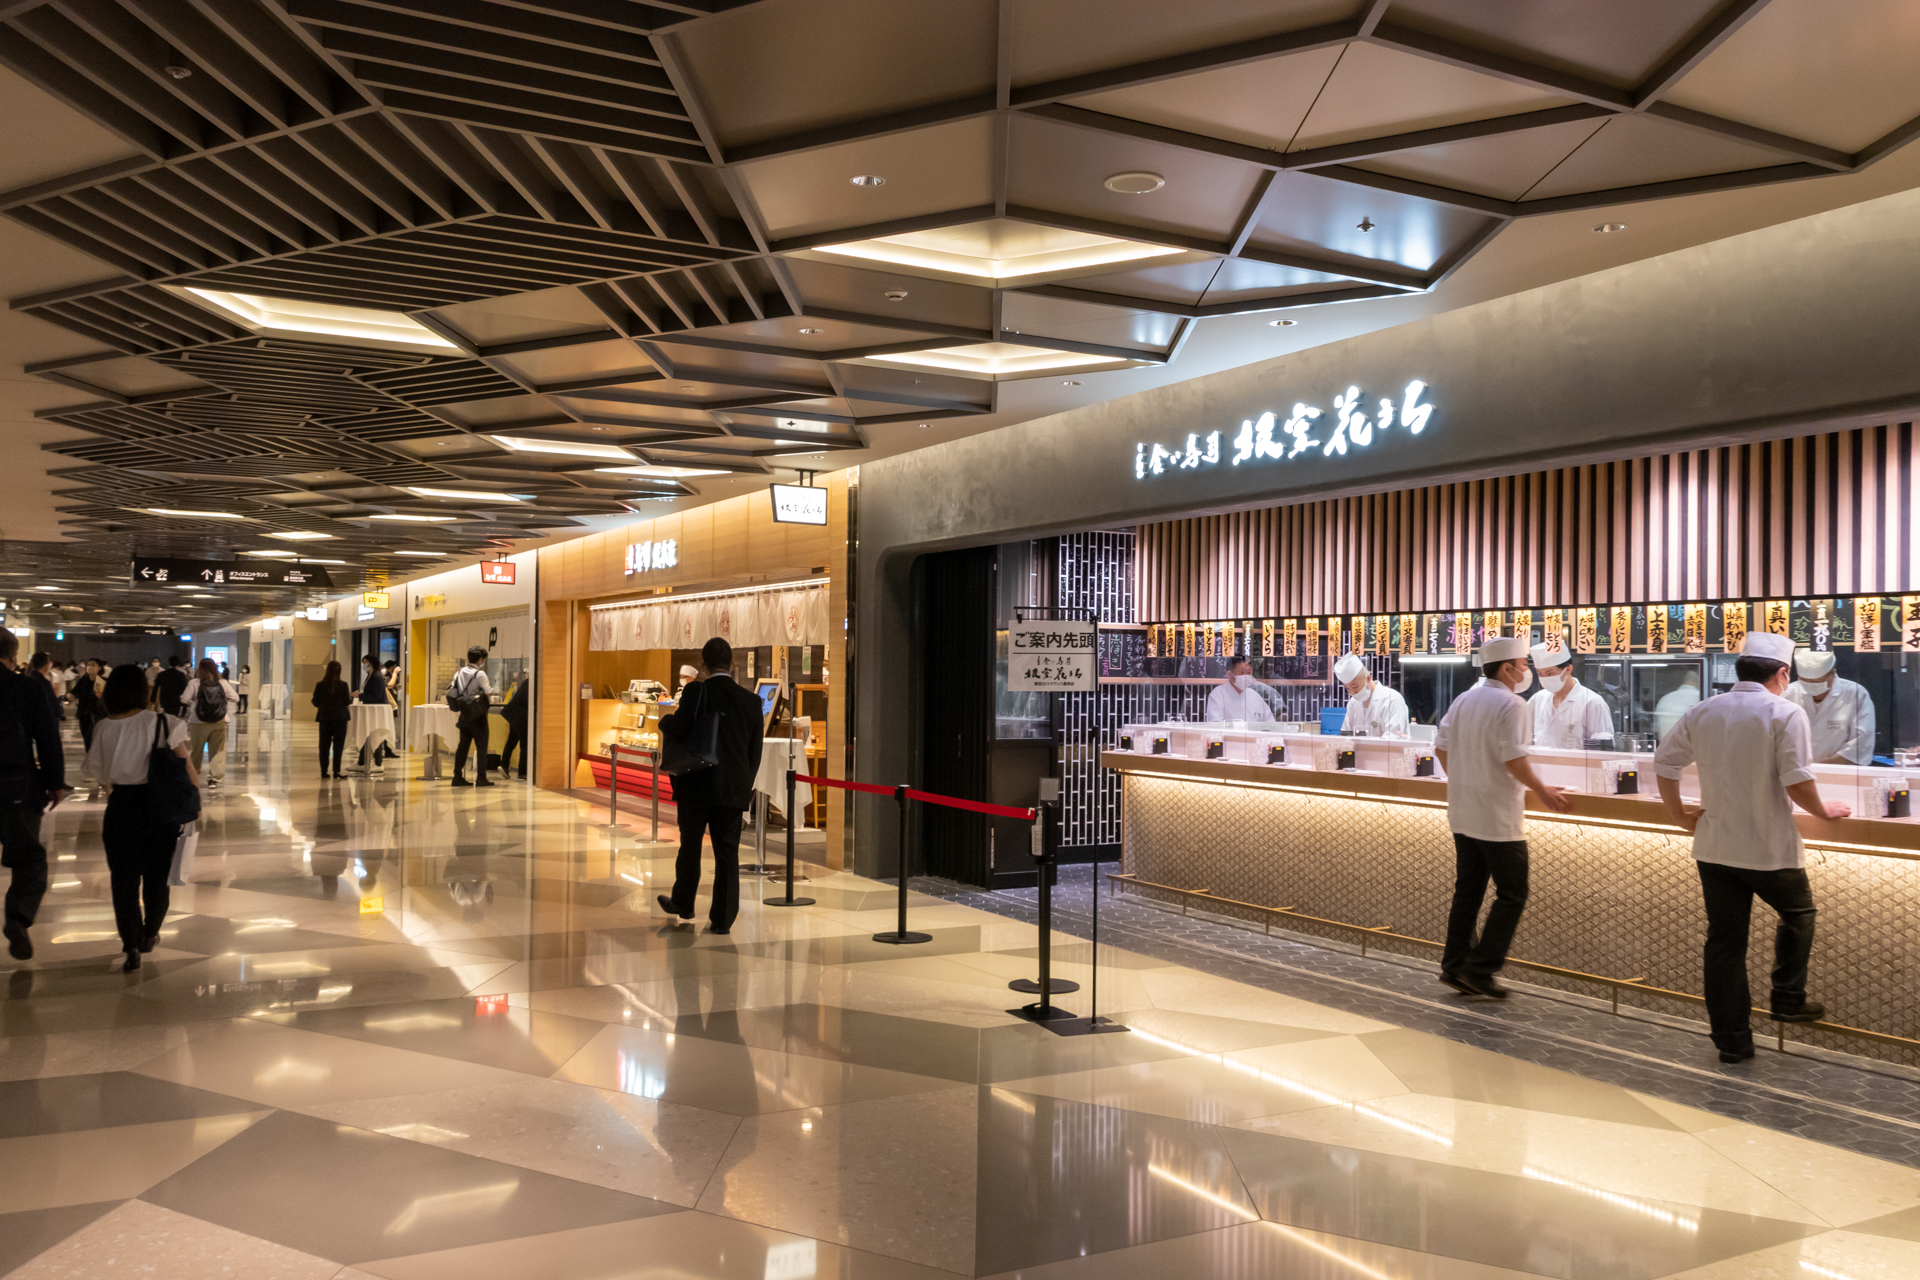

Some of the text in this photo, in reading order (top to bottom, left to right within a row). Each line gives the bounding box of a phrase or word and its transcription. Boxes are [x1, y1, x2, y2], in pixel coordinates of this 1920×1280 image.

[1232, 380, 1436, 466] 根室花まる
[1014, 631, 1095, 648] ご案内先頭
[1205, 626, 1213, 655] 中とろ
[1264, 624, 1273, 655] いくら
[1377, 619, 1388, 655] 活つぶ貝
[1487, 615, 1499, 640] 鮭のめ
[1522, 614, 1530, 639] 炙り
[1553, 613, 1561, 653] 炙りとろ
[1579, 616, 1588, 651] たらこ
[1614, 610, 1627, 653] 炙りにしん
[1649, 610, 1665, 653] 上赤身
[1725, 608, 1736, 651] 山わさび
[1734, 607, 1745, 641] 真いか
[1813, 604, 1830, 652] 一皿一九〇円
[1859, 601, 1877, 650] 切落し軍艦
[1024, 666, 1083, 681] 根室花まる
